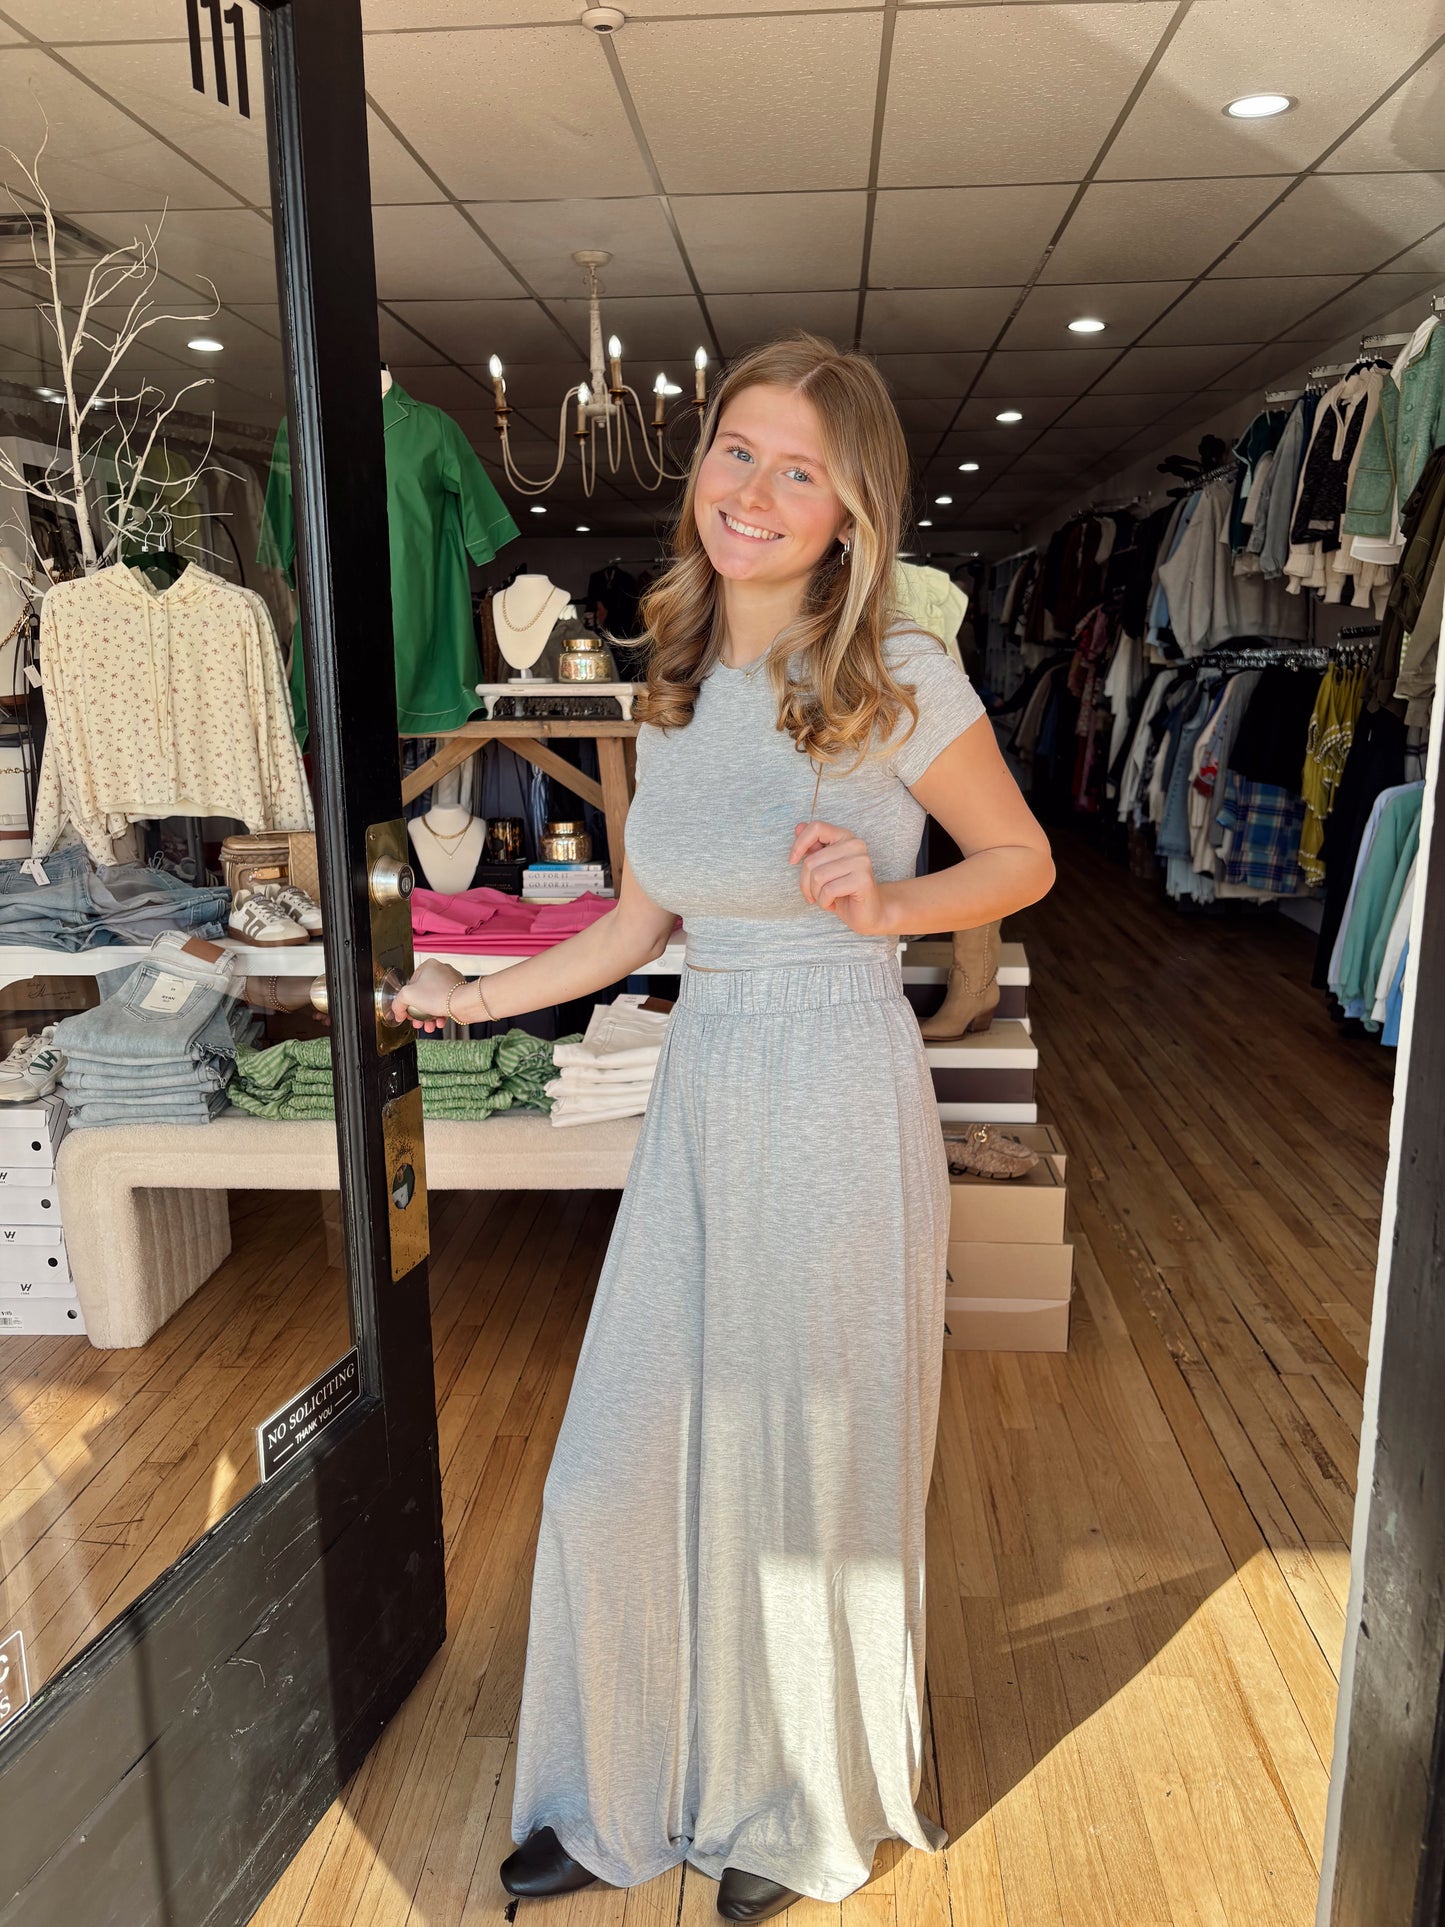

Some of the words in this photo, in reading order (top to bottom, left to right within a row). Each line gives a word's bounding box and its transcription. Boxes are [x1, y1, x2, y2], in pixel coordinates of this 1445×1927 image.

[186, 0, 251, 120] 111
[267, 1422, 287, 1450] NO
[289, 1362, 355, 1431] SOLICITING
[294, 1418, 318, 1445] THANK
[318, 1406, 333, 1424] YOU
